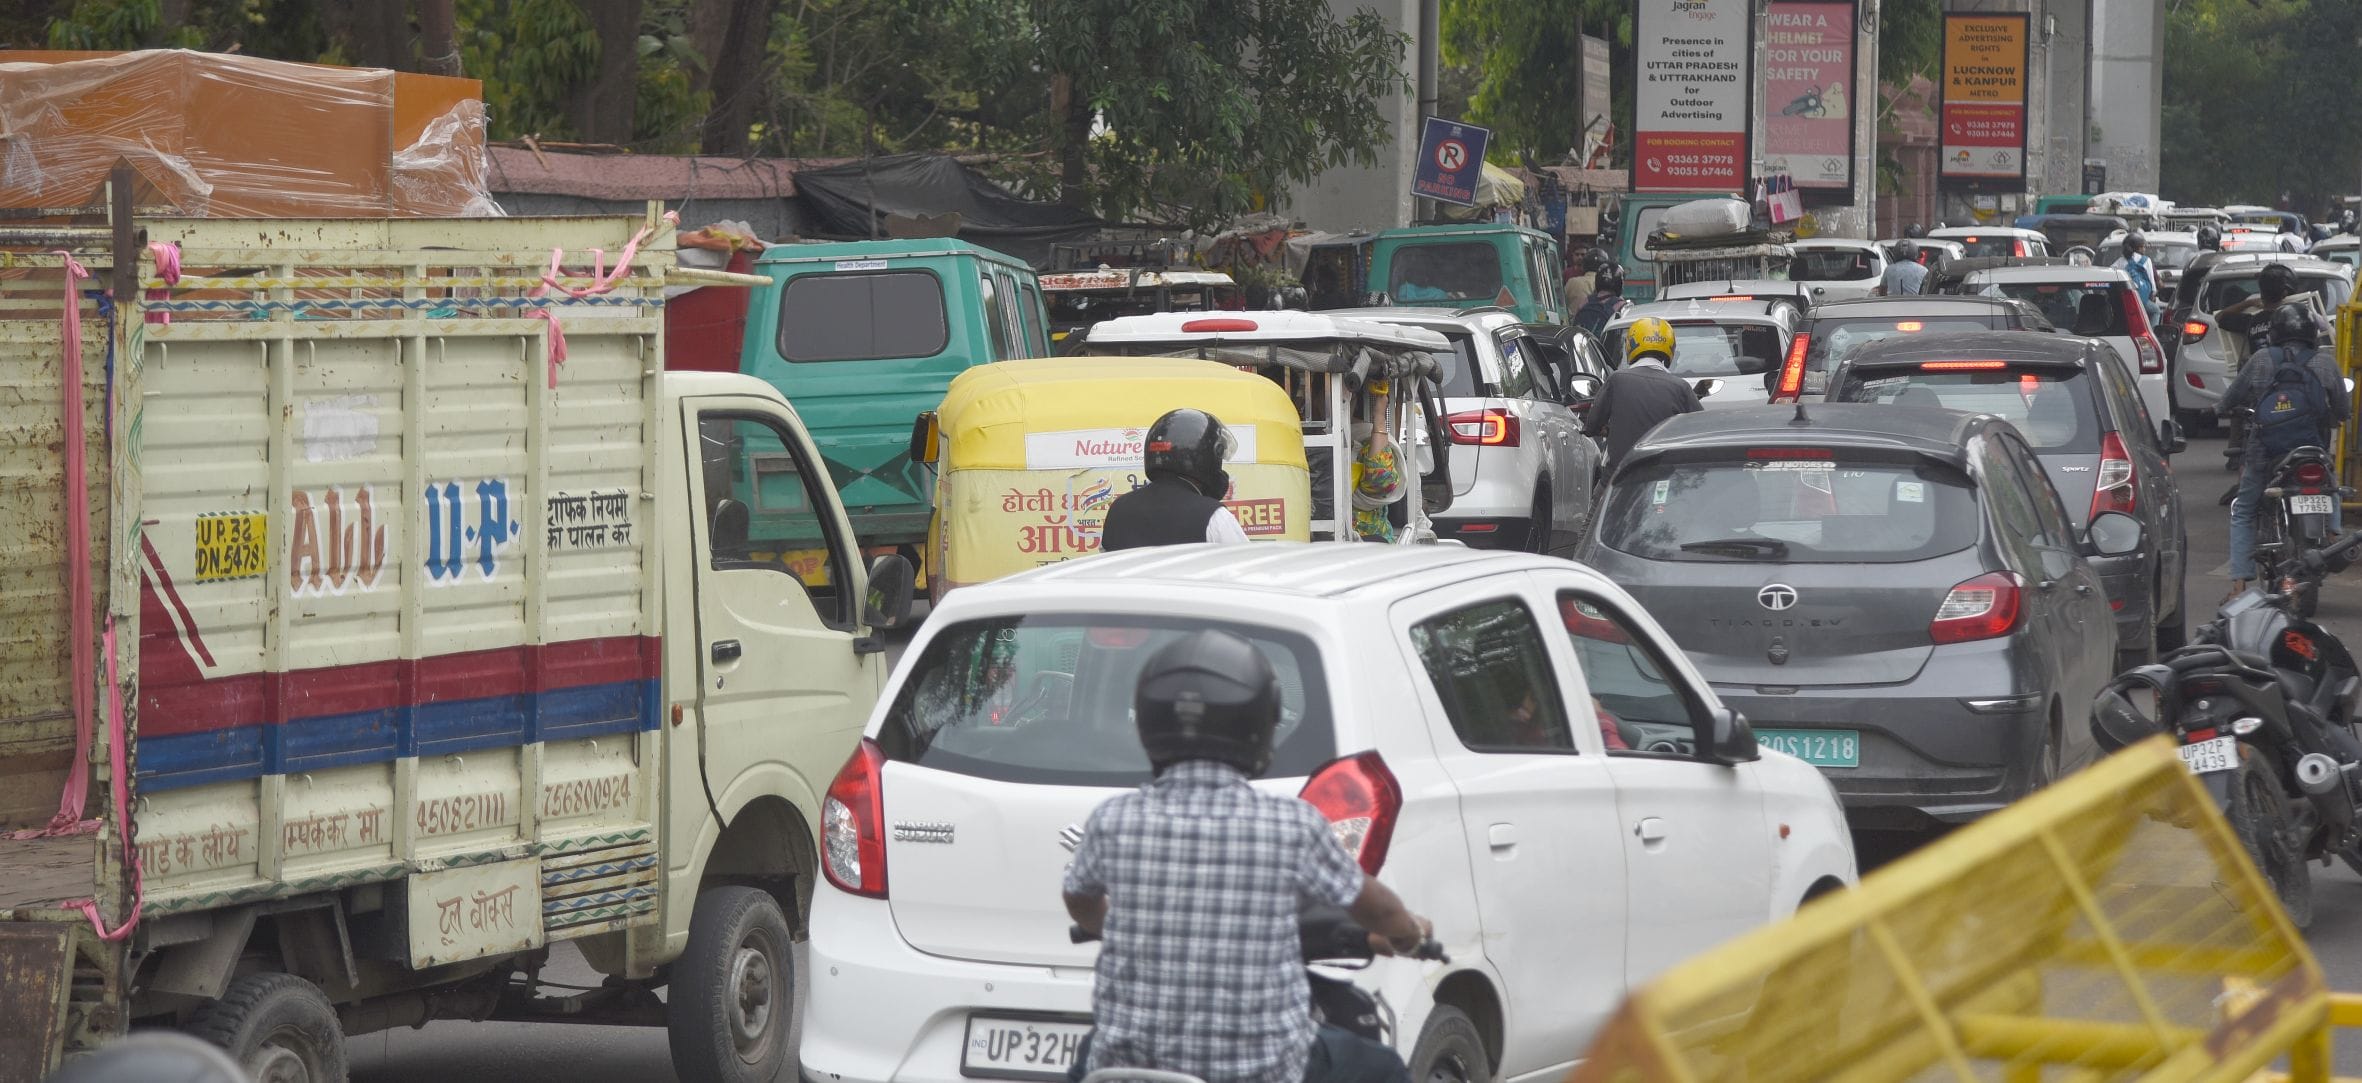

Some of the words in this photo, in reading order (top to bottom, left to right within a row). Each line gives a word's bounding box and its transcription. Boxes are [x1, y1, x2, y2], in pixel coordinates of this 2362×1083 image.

[1672, 1, 1706, 11] Jagran
[1689, 10, 1717, 21] Engage
[1769, 13, 1812, 27] WEAR
[1816, 14, 1828, 27] A
[1662, 37, 1712, 45] Presence
[1714, 37, 1724, 45] in
[1768, 31, 1824, 44] HELMET
[1672, 49, 1701, 57] cities
[1703, 49, 1715, 57] of
[1768, 49, 1797, 62] FOR
[1801, 49, 1843, 63] YOUR
[1647, 61, 1683, 70] UTTAR
[1686, 62, 1738, 70] PRADESH
[1953, 66, 2016, 75] LUCKNOW
[1660, 74, 1736, 82] UTTRAKHAND
[1767, 67, 1819, 80] SAFETY
[1953, 77, 1961, 86] &
[1965, 77, 2017, 86] KANPUR
[1684, 86, 1700, 94] for
[1670, 98, 1714, 107] Outdoor
[1661, 110, 1722, 120] Advertising
[1667, 154, 1698, 164] 93362
[1702, 155, 1734, 165] 37978
[1667, 166, 1698, 176] 93055
[1702, 167, 1734, 177] 67446
[1438, 174, 1456, 186] NO
[1417, 180, 1472, 201] PARKING
[1642, 334, 1667, 344] rapido
[2274, 400, 2292, 410] Jai
[1075, 439, 1142, 457] Nature
[1001, 488, 1054, 512] होली
[291, 483, 385, 592] ALL
[567, 525, 608, 549] पालन
[2183, 740, 2223, 759] UP32P
[2184, 755, 2226, 772] 4439
[895, 830, 954, 843] SUZUKI
[971, 1039, 988, 1049] IND
